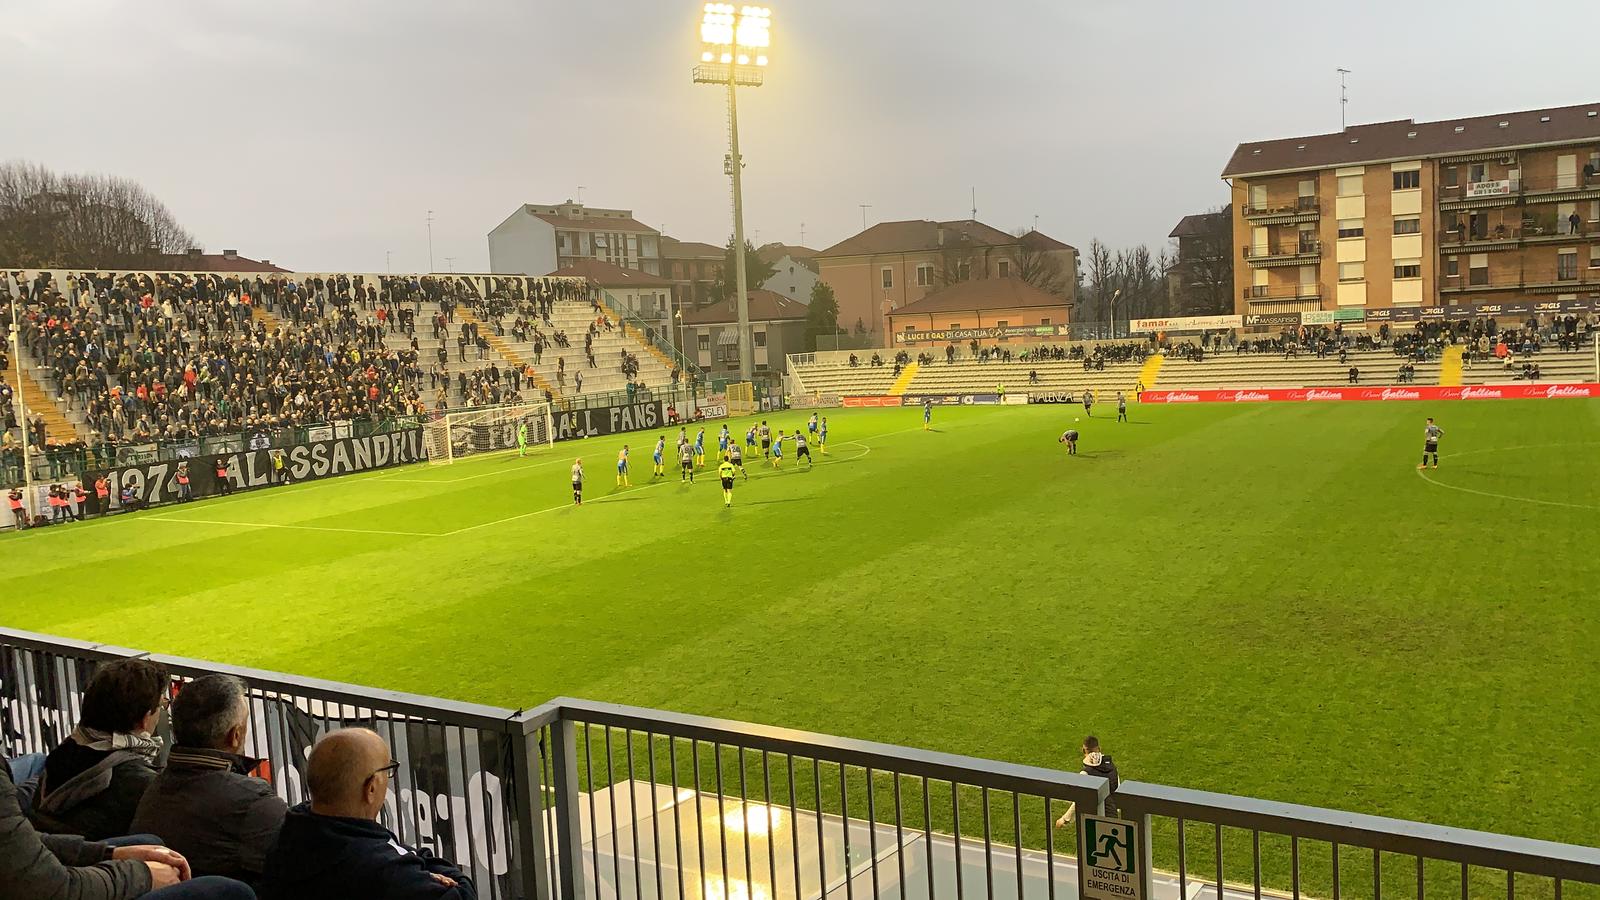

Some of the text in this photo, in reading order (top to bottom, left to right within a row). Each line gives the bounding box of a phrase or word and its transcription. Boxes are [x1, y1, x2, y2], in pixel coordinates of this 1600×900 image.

[1136, 320, 1168, 328] famar
[1246, 315, 1260, 324] MF
[1166, 392, 1199, 402] Gallina
[1235, 391, 1269, 401] Gallina
[1306, 389, 1342, 401] Gallina
[1382, 388, 1419, 400] Gallina
[1461, 387, 1501, 400] Gallina
[1546, 385, 1589, 398] Gallina
[609, 403, 657, 433] FANS
[1092, 868, 1130, 883] USCITA DI
[1087, 879, 1136, 896] EMERGENZA
